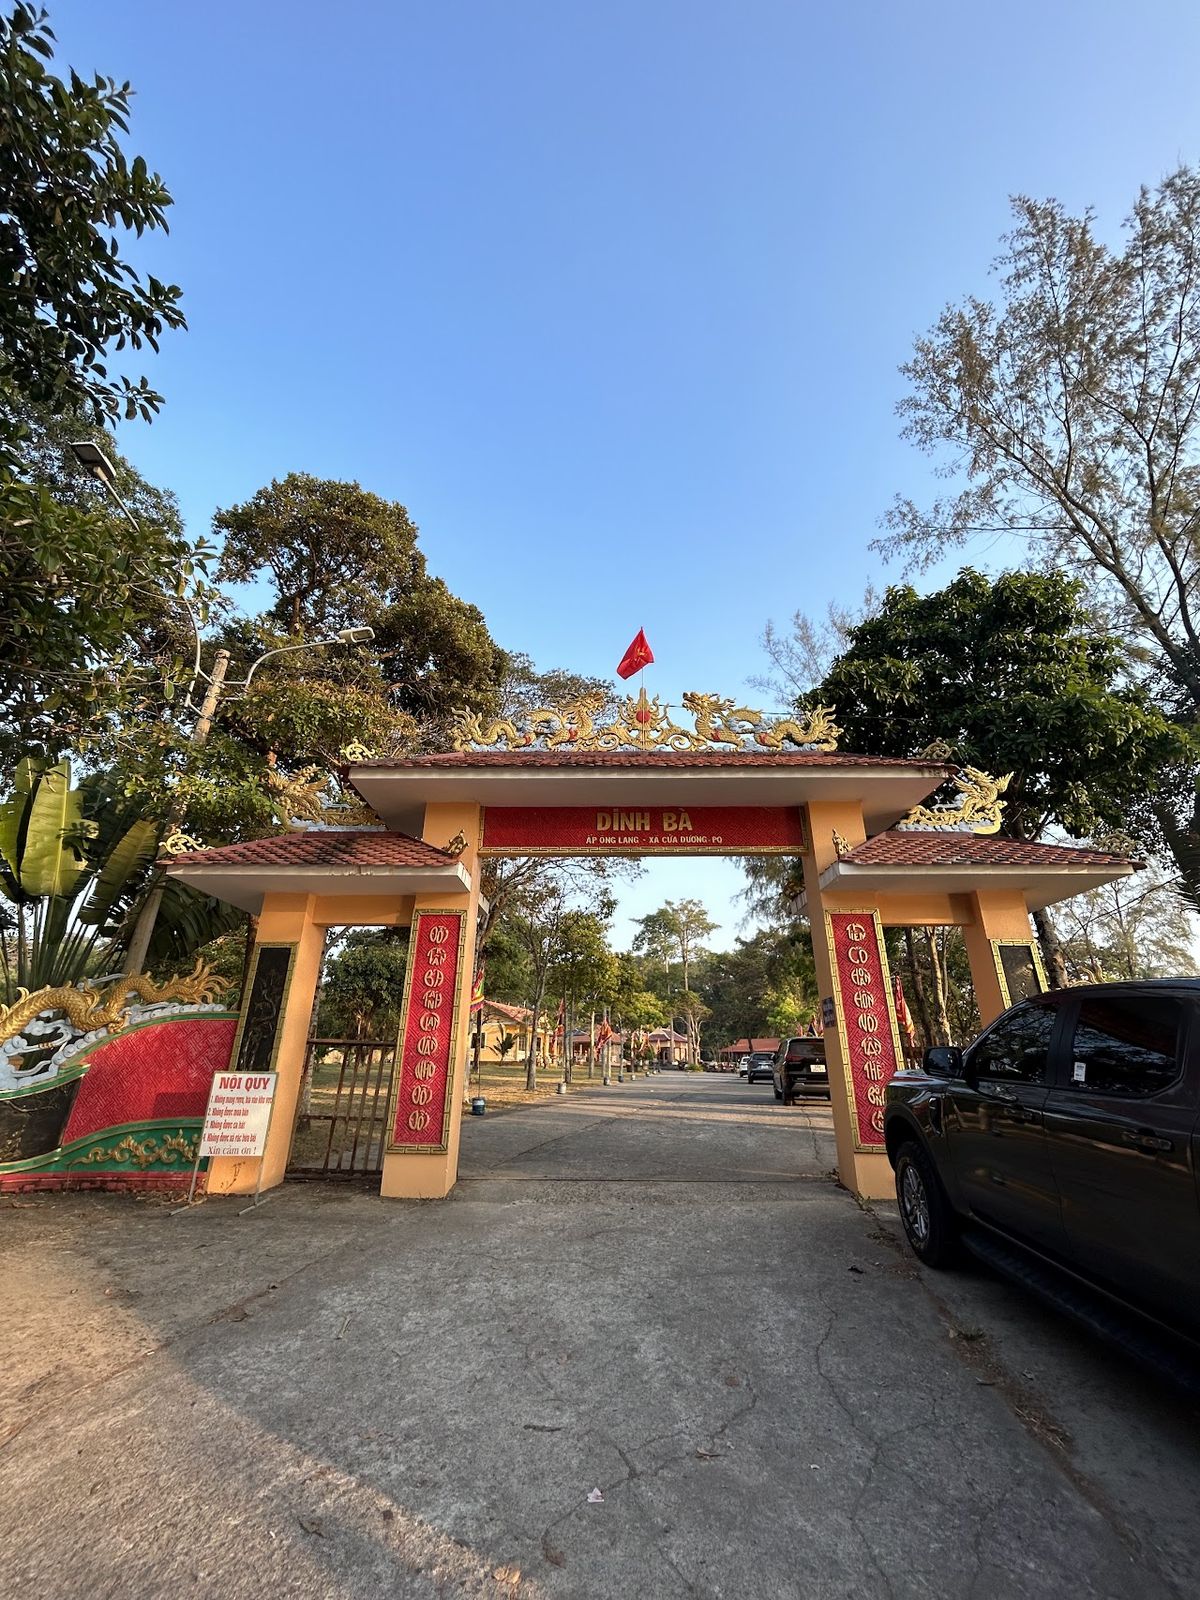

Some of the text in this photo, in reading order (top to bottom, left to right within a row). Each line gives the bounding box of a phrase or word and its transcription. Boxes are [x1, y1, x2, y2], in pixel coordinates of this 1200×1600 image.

[663, 807, 693, 831] BÀ
[618, 836, 639, 844] LANG
[219, 1075, 271, 1092] NỘI QUY
[208, 1146, 221, 1154] Xin
